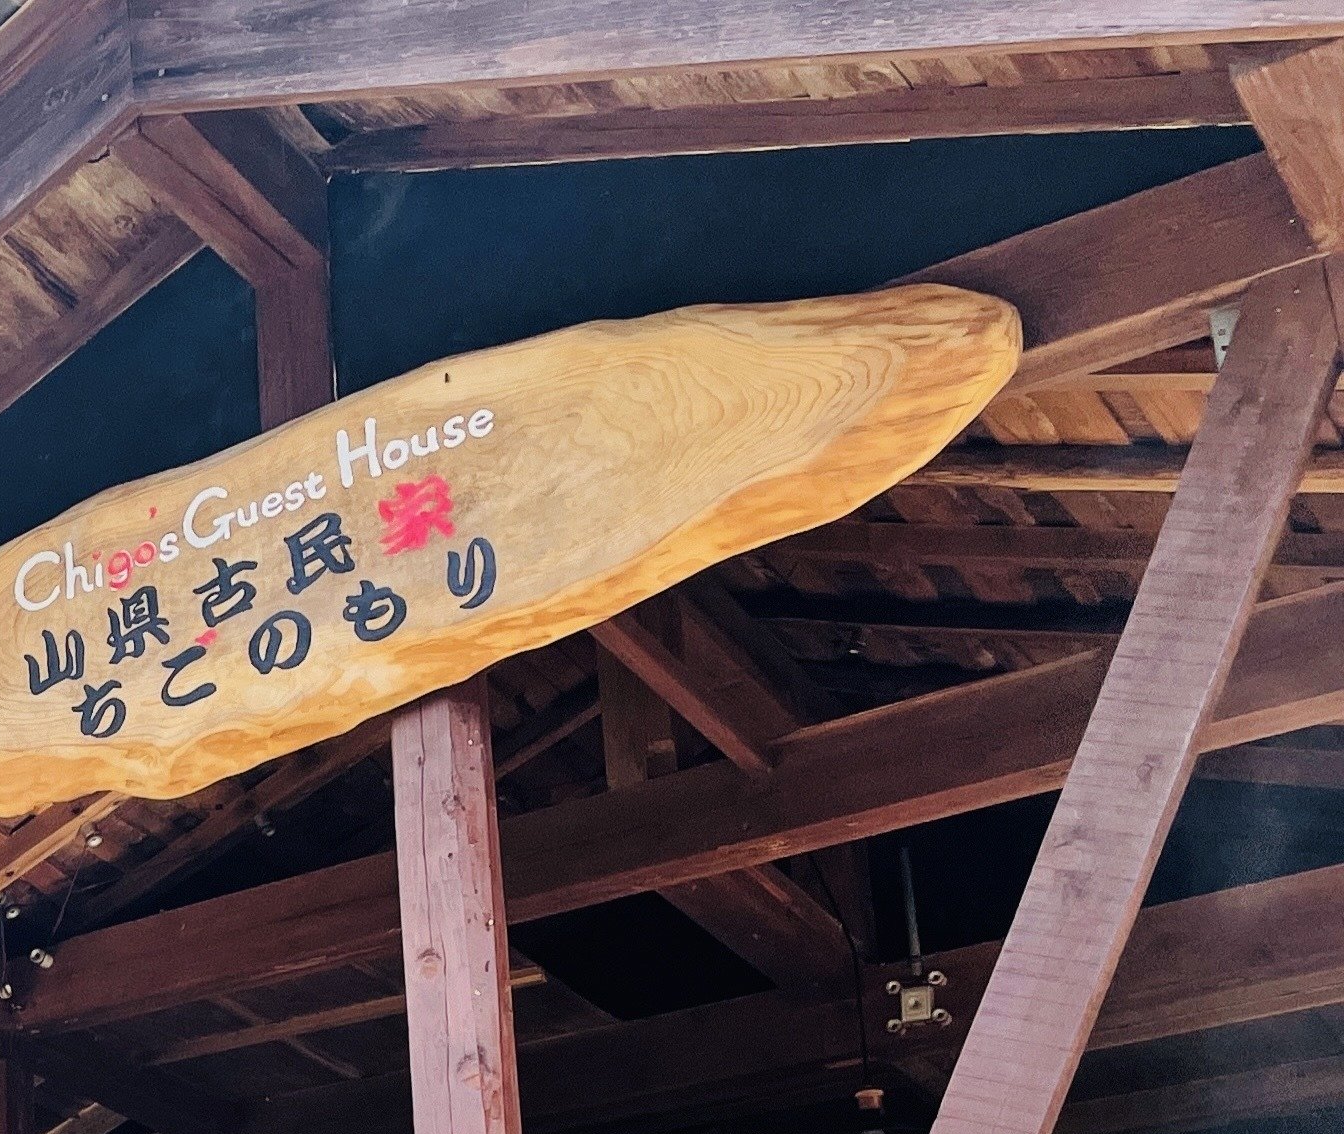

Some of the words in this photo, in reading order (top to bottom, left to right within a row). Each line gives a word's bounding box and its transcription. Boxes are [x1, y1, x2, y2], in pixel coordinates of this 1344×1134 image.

[182, 470, 326, 549] Guest
[336, 408, 495, 488] House
[23, 476, 455, 697] 山県古民家
